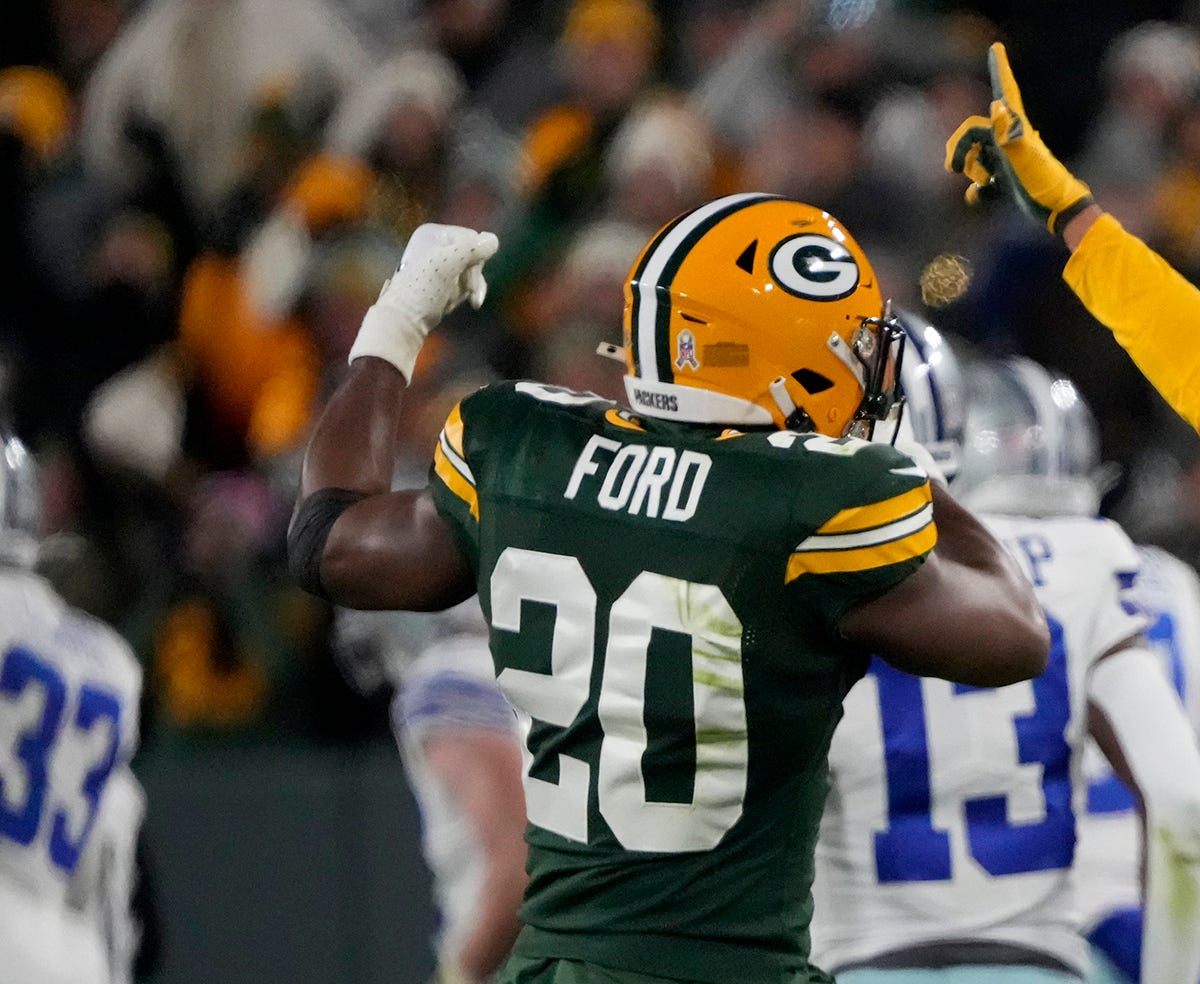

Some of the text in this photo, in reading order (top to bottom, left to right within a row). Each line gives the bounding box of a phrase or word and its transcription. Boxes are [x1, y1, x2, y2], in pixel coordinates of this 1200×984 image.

[770, 233, 859, 298] G
[564, 434, 713, 522] FORD
[0, 646, 122, 871] 33
[490, 546, 749, 852] 20
[866, 608, 1076, 883] 13
